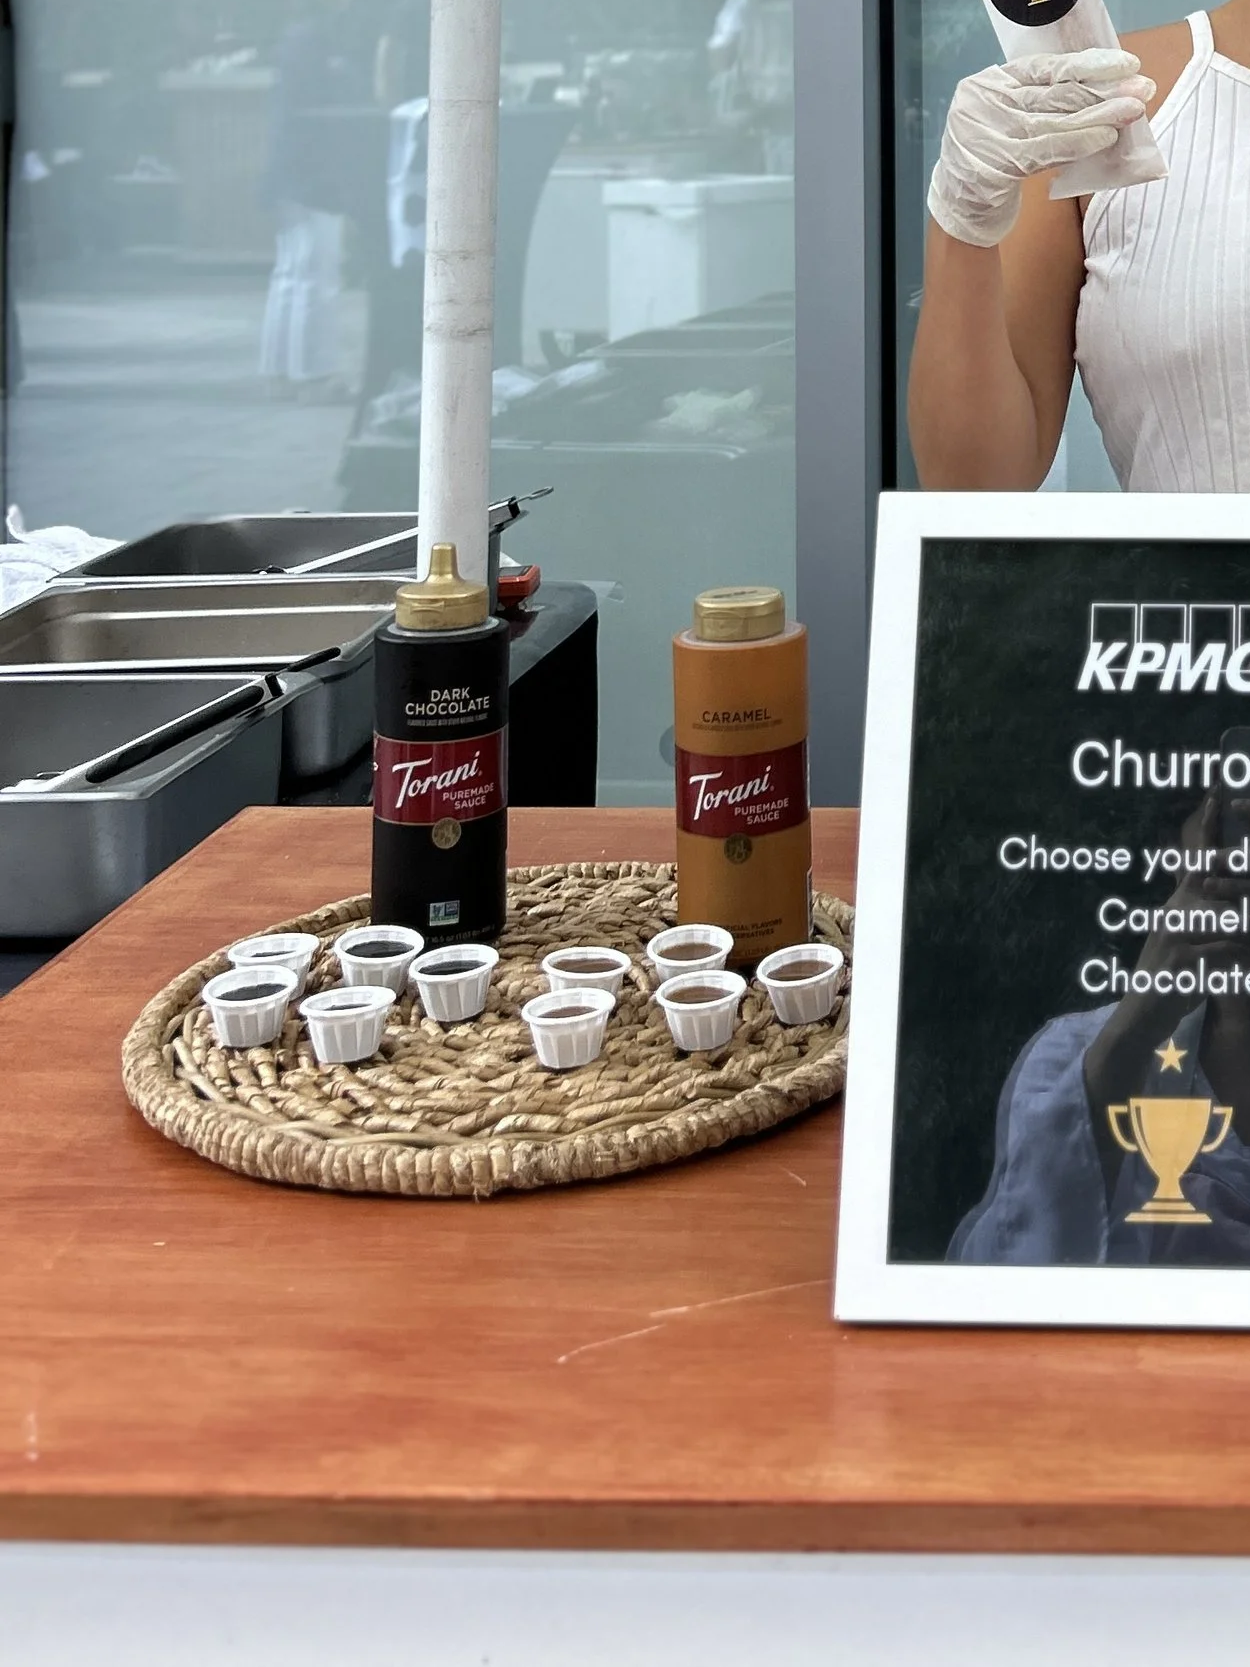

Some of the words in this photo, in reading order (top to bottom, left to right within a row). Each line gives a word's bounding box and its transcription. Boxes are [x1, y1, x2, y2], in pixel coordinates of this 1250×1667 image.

[431, 687, 470, 702] DARK
[405, 696, 490, 716] CHOCOLATE
[702, 709, 772, 723] CARAMEL
[392, 750, 481, 809] Torani
[442, 783, 494, 802] PUREMADE
[689, 765, 772, 821] Torani
[454, 796, 486, 810] SAUCE
[734, 797, 790, 816] PUREMADE
[747, 811, 780, 825] SAUCE
[999, 835, 1132, 872] Choose
[1144, 845, 1217, 882] your
[1098, 897, 1249, 934] Caramel
